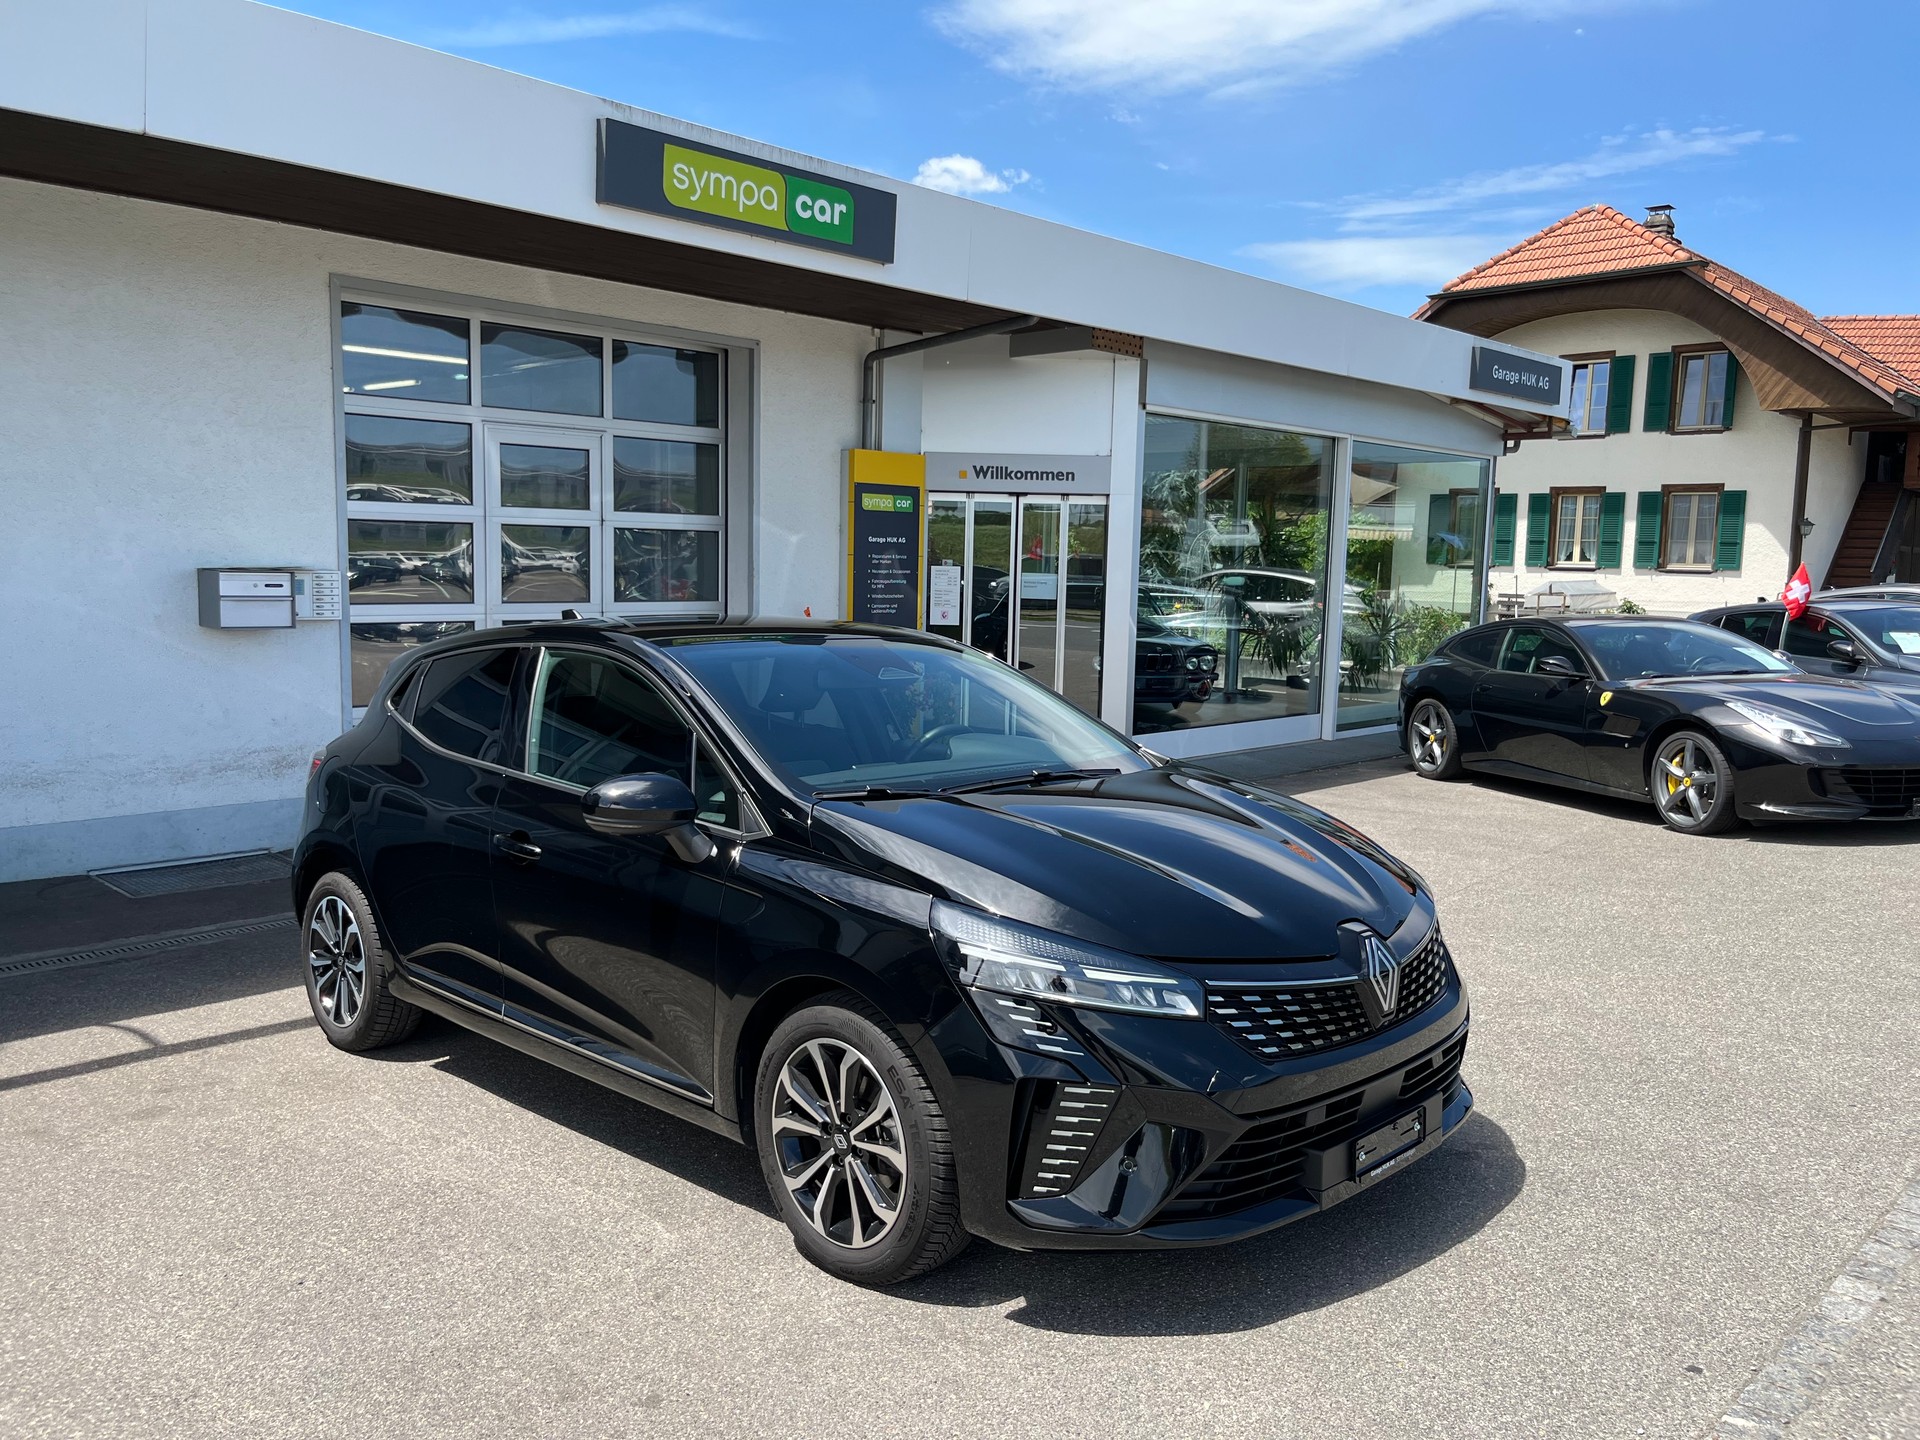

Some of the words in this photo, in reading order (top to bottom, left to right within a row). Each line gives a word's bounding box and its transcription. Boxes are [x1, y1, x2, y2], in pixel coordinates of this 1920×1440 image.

[672, 162, 779, 213] sympa
[794, 193, 847, 226] car
[1492, 364, 1520, 385] Garage
[1521, 371, 1538, 388] HUK
[1538, 375, 1550, 390] AG
[972, 465, 1076, 482] Willkommen
[864, 497, 892, 509] sympa
[896, 499, 911, 508] car
